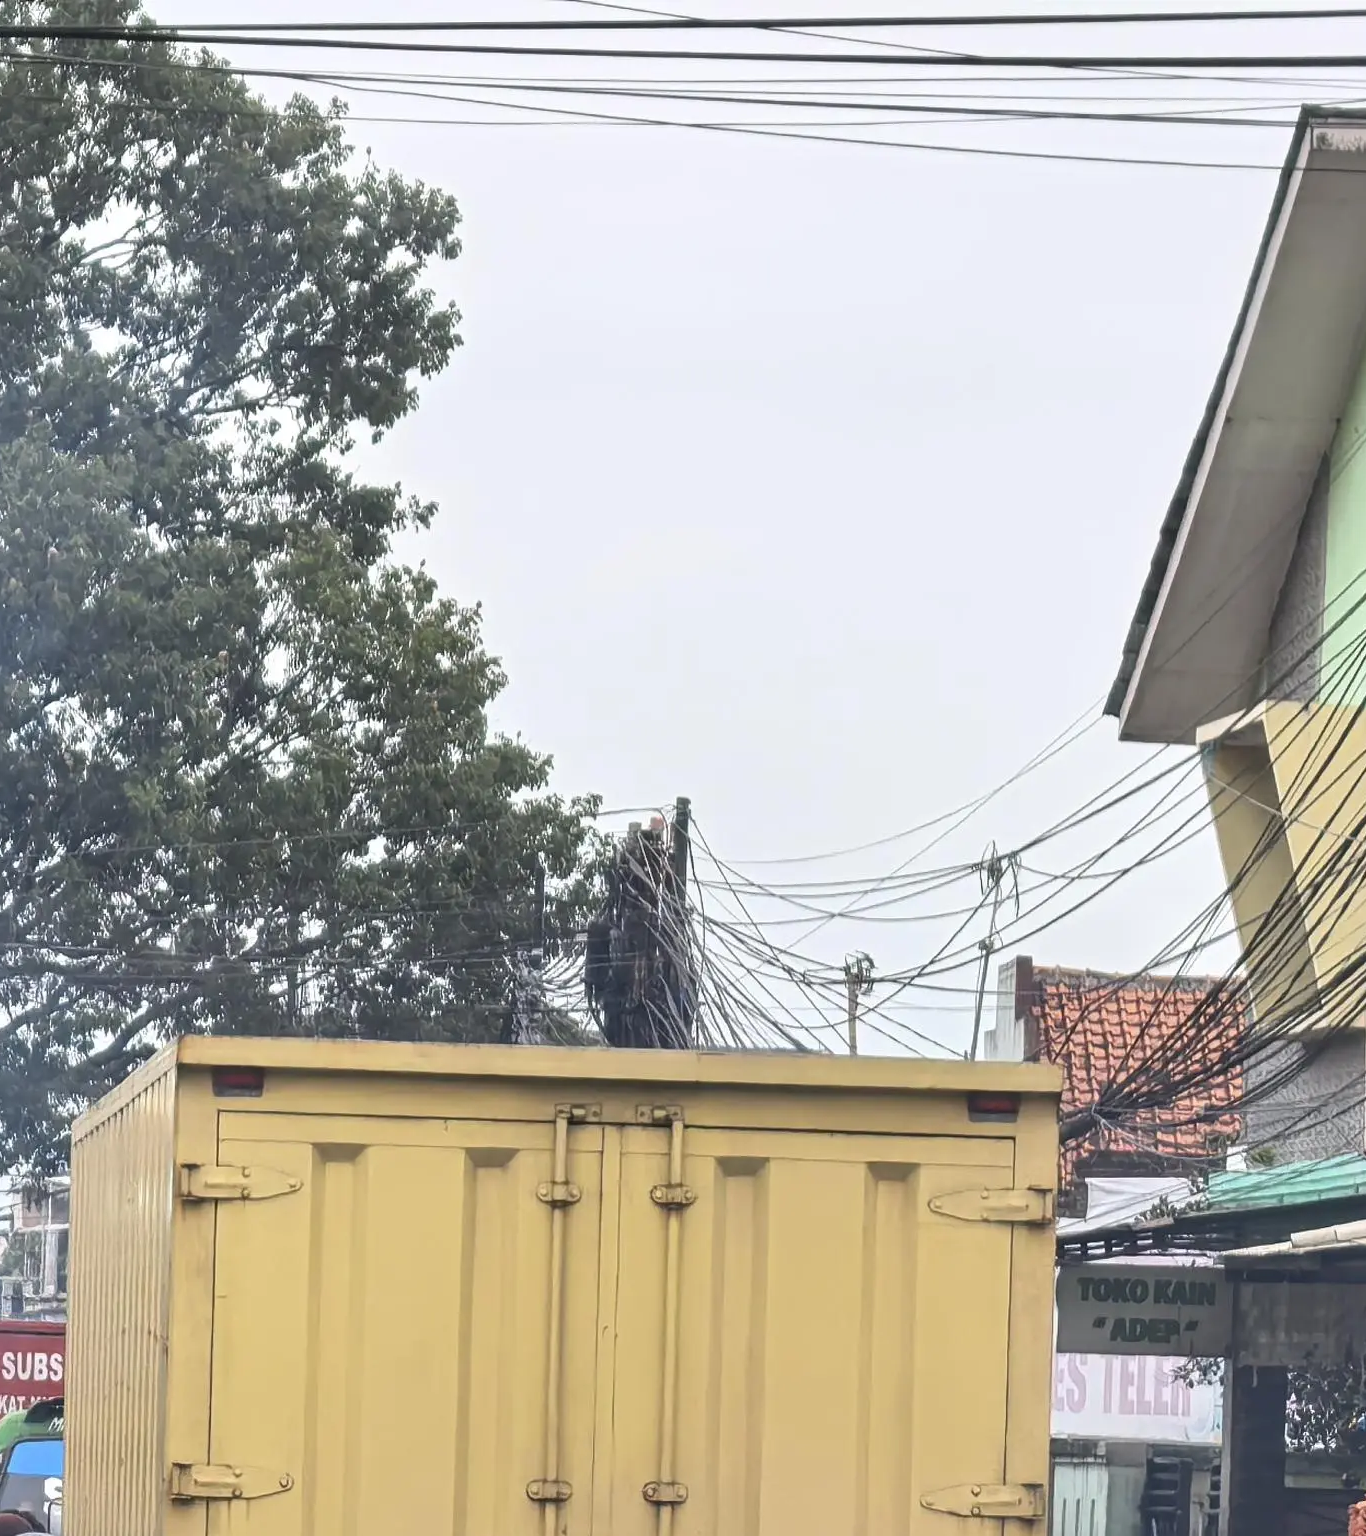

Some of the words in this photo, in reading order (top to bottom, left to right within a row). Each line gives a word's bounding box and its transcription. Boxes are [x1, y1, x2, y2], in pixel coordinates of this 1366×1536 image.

[1076, 1277, 1149, 1304] TOKO
[1153, 1278, 1216, 1306] KAIN
[1, 1351, 64, 1382] SUBS
